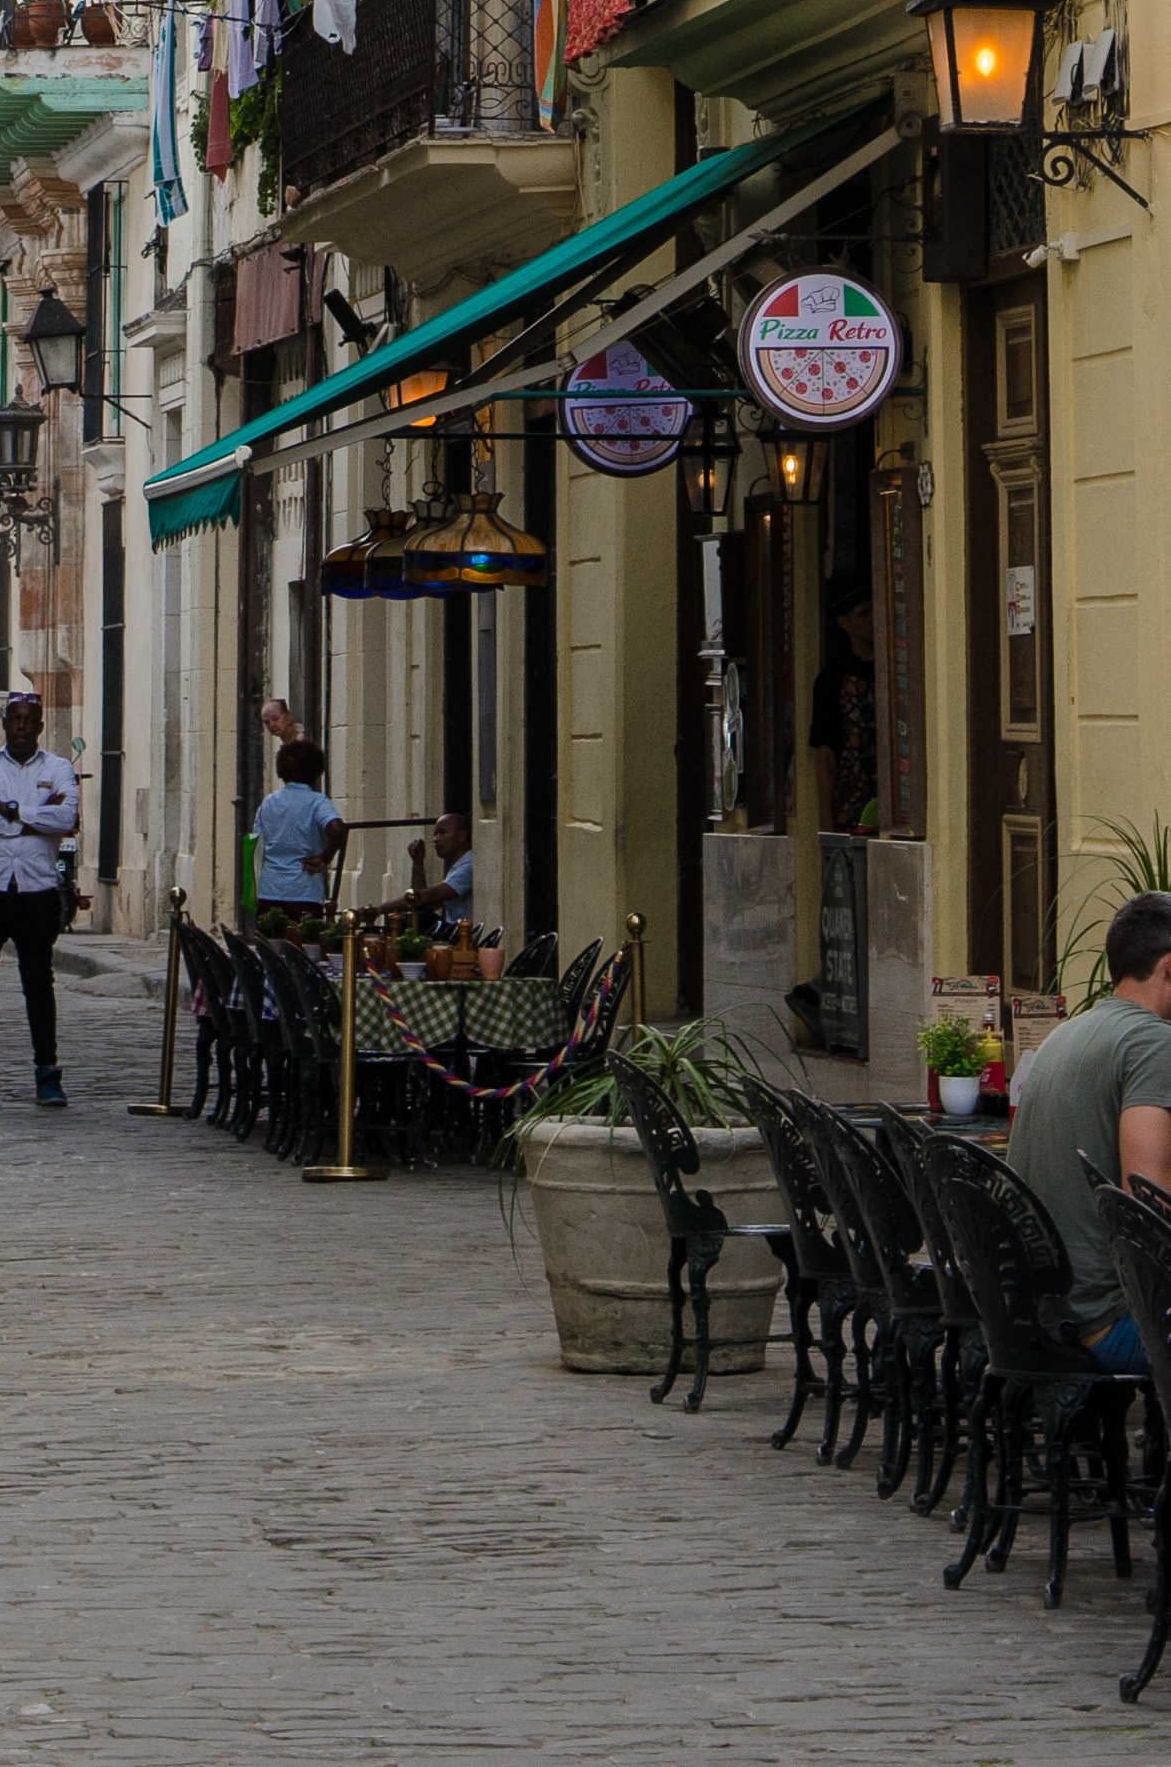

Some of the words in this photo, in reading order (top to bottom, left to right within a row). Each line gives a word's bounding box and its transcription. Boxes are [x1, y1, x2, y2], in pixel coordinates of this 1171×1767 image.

[760, 319, 819, 341] Pizza
[828, 319, 887, 341] Retro
[826, 949, 854, 985] STATE
